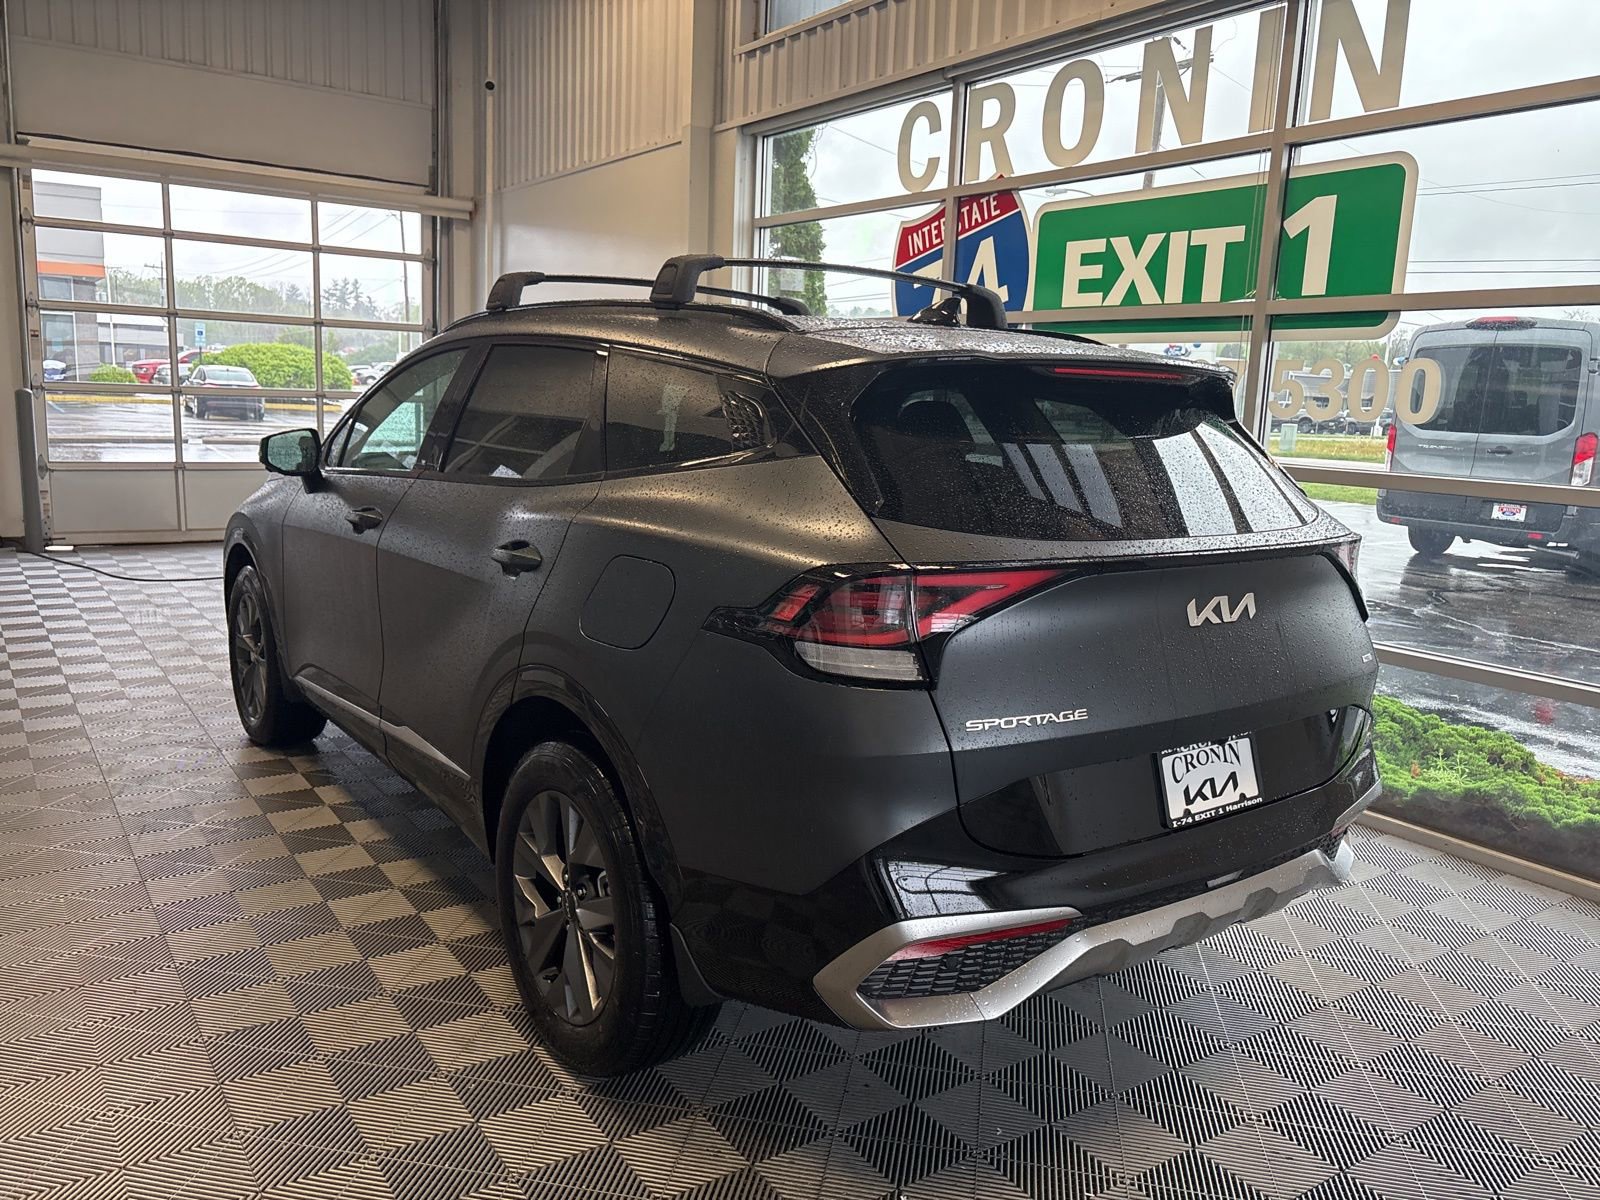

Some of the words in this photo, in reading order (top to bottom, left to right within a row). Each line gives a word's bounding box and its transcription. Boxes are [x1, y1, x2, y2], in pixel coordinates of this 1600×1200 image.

[898, 0, 1410, 192] CRONIN
[908, 193, 1000, 256] INTETATE
[1061, 225, 1246, 308] EXIT
[1283, 194, 1337, 296] 1
[1268, 358, 1442, 425] 5300
[965, 708, 1089, 731] SPORTAGE
[1171, 741, 1241, 784] CRONIN
[1172, 816, 1193, 828] I-74
[1194, 809, 1217, 821] EXIT
[1218, 807, 1224, 815] 1
[1225, 797, 1263, 812] Harrison
